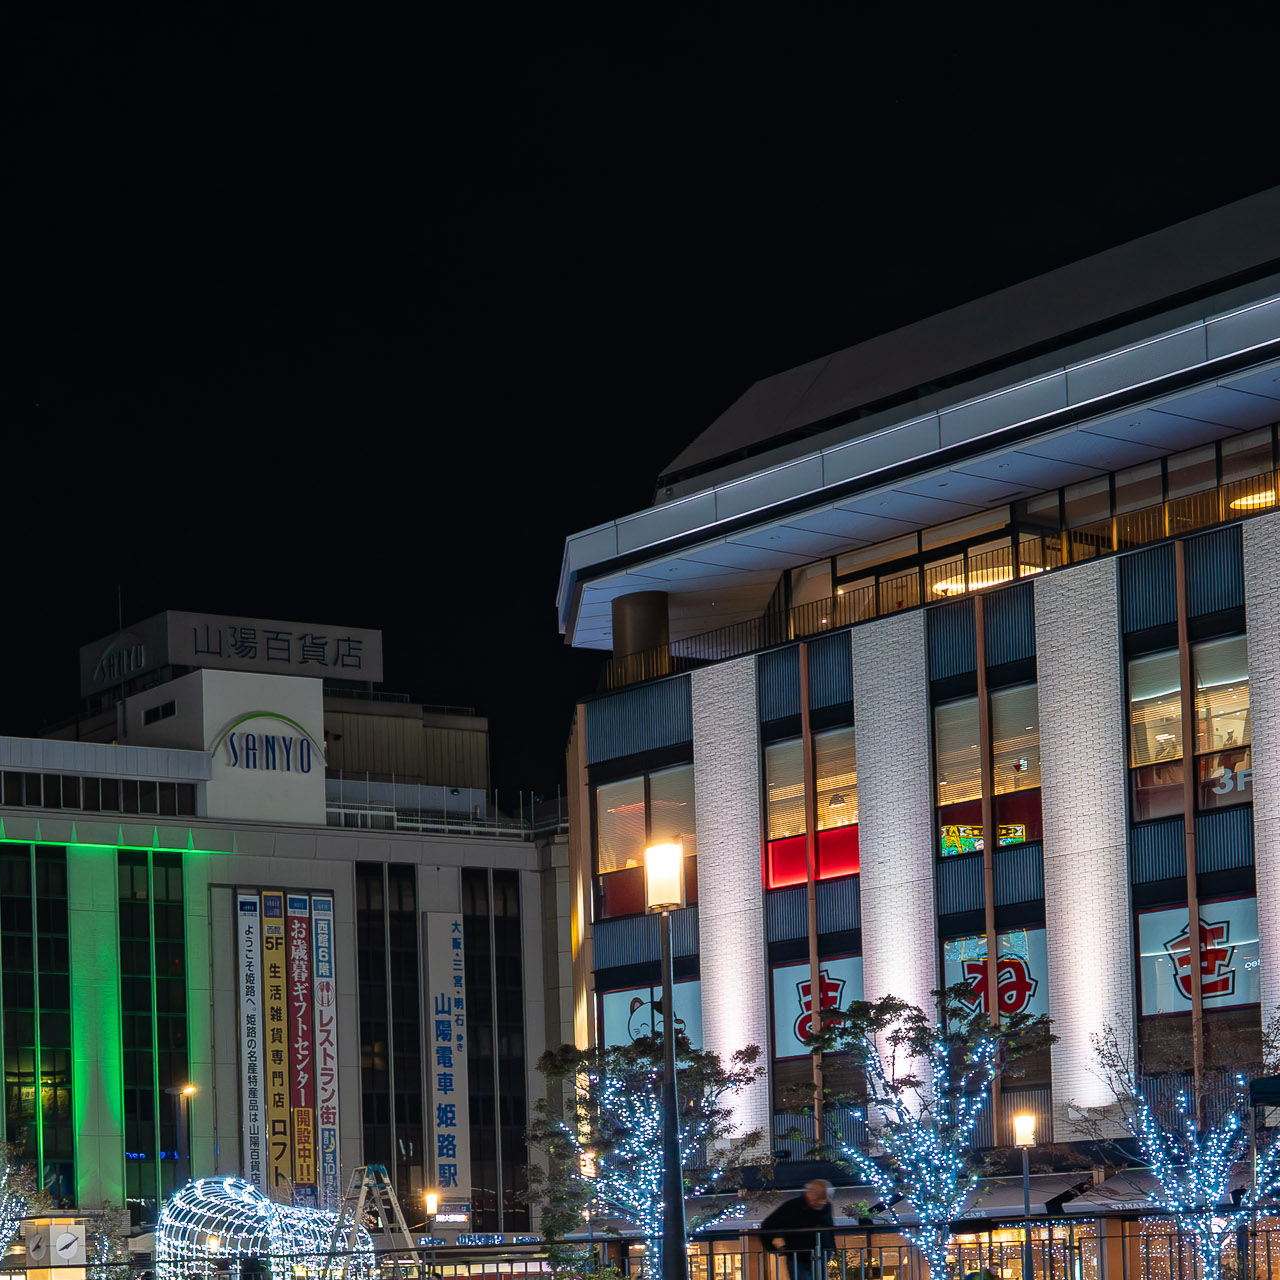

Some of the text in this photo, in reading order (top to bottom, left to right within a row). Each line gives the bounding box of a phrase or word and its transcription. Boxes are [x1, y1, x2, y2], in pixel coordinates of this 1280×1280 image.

[100, 643, 145, 682] SANYO
[193, 623, 364, 670] 山陽百貨店
[229, 731, 312, 774] SANYO
[265, 936, 283, 951] 5F
[451, 920, 464, 1027] 大阪・三宮・明石
[290, 919, 310, 1107] お歳暮ギフトセンター
[434, 992, 454, 1095] 山陽電車
[268, 962, 288, 1188] 生活雑貨専門店 ロフト
[319, 1009, 338, 1127] レストラン街
[436, 1103, 458, 1188] 姫路駅
